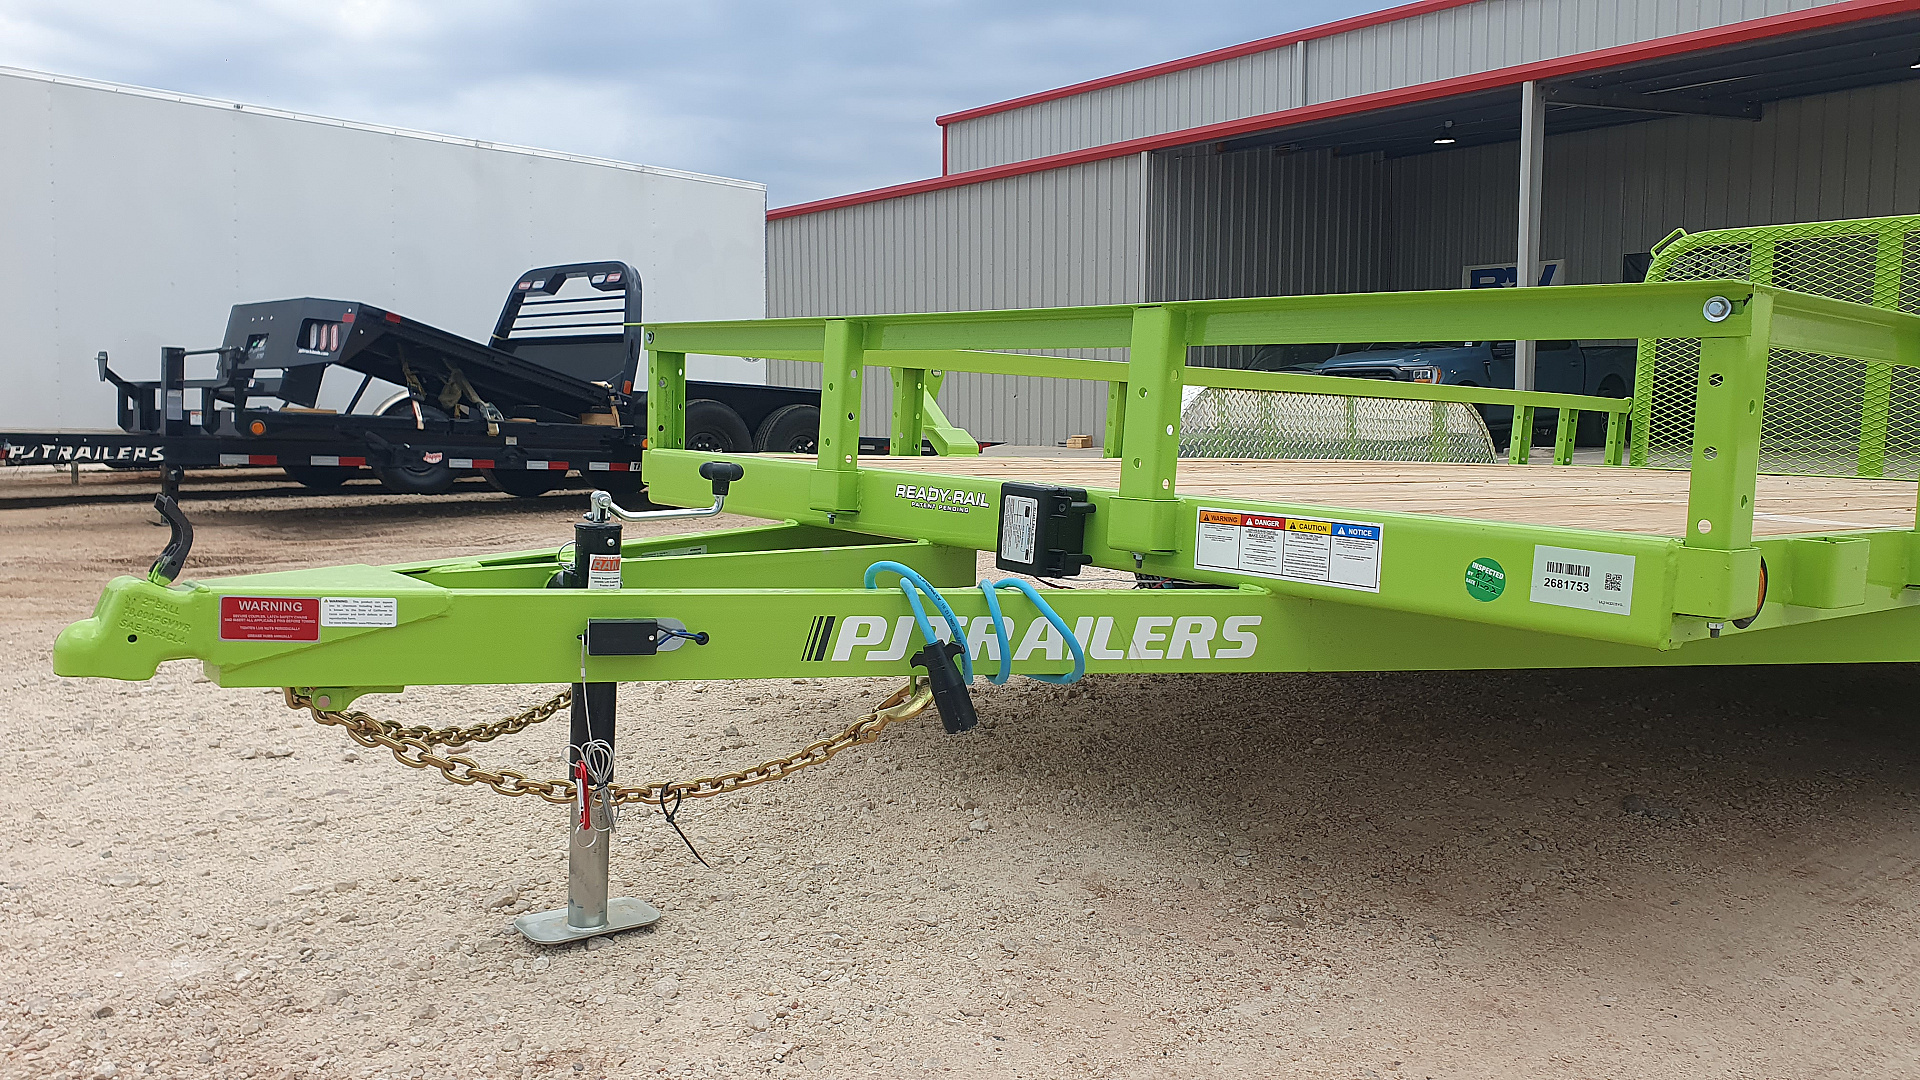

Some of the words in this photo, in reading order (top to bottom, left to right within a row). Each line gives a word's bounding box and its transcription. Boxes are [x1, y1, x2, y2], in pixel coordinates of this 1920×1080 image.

[41, 443, 165, 461] TRAILERS
[911, 501, 936, 510] PATENT
[938, 504, 969, 514] PENDING
[1210, 514, 1238, 523] WARNING
[1254, 518, 1280, 527] DANGER
[1298, 523, 1327, 532] CAUTION
[1348, 528, 1372, 537] NOTICE
[1471, 561, 1504, 580] INSPECTED
[1543, 577, 1590, 593] 2681753
[238, 600, 303, 612] WARNING
[118, 619, 142, 632] SAE
